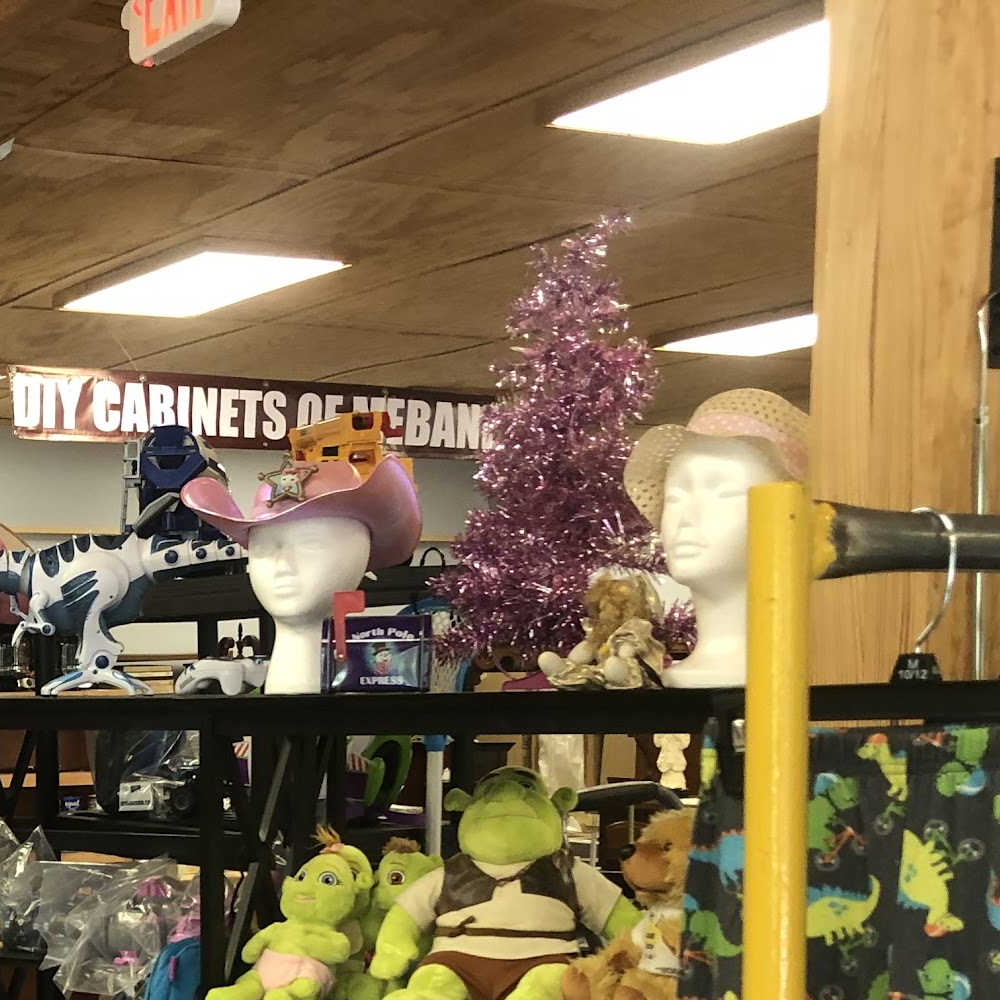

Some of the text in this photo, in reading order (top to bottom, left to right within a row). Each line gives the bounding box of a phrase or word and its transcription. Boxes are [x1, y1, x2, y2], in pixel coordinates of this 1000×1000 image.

[14, 374, 85, 430] DIY
[93, 380, 287, 440] CABINETS
[351, 627, 415, 640] North Pole
[360, 676, 404, 685] EXPRESS
[898, 669, 928, 680] 10/12
